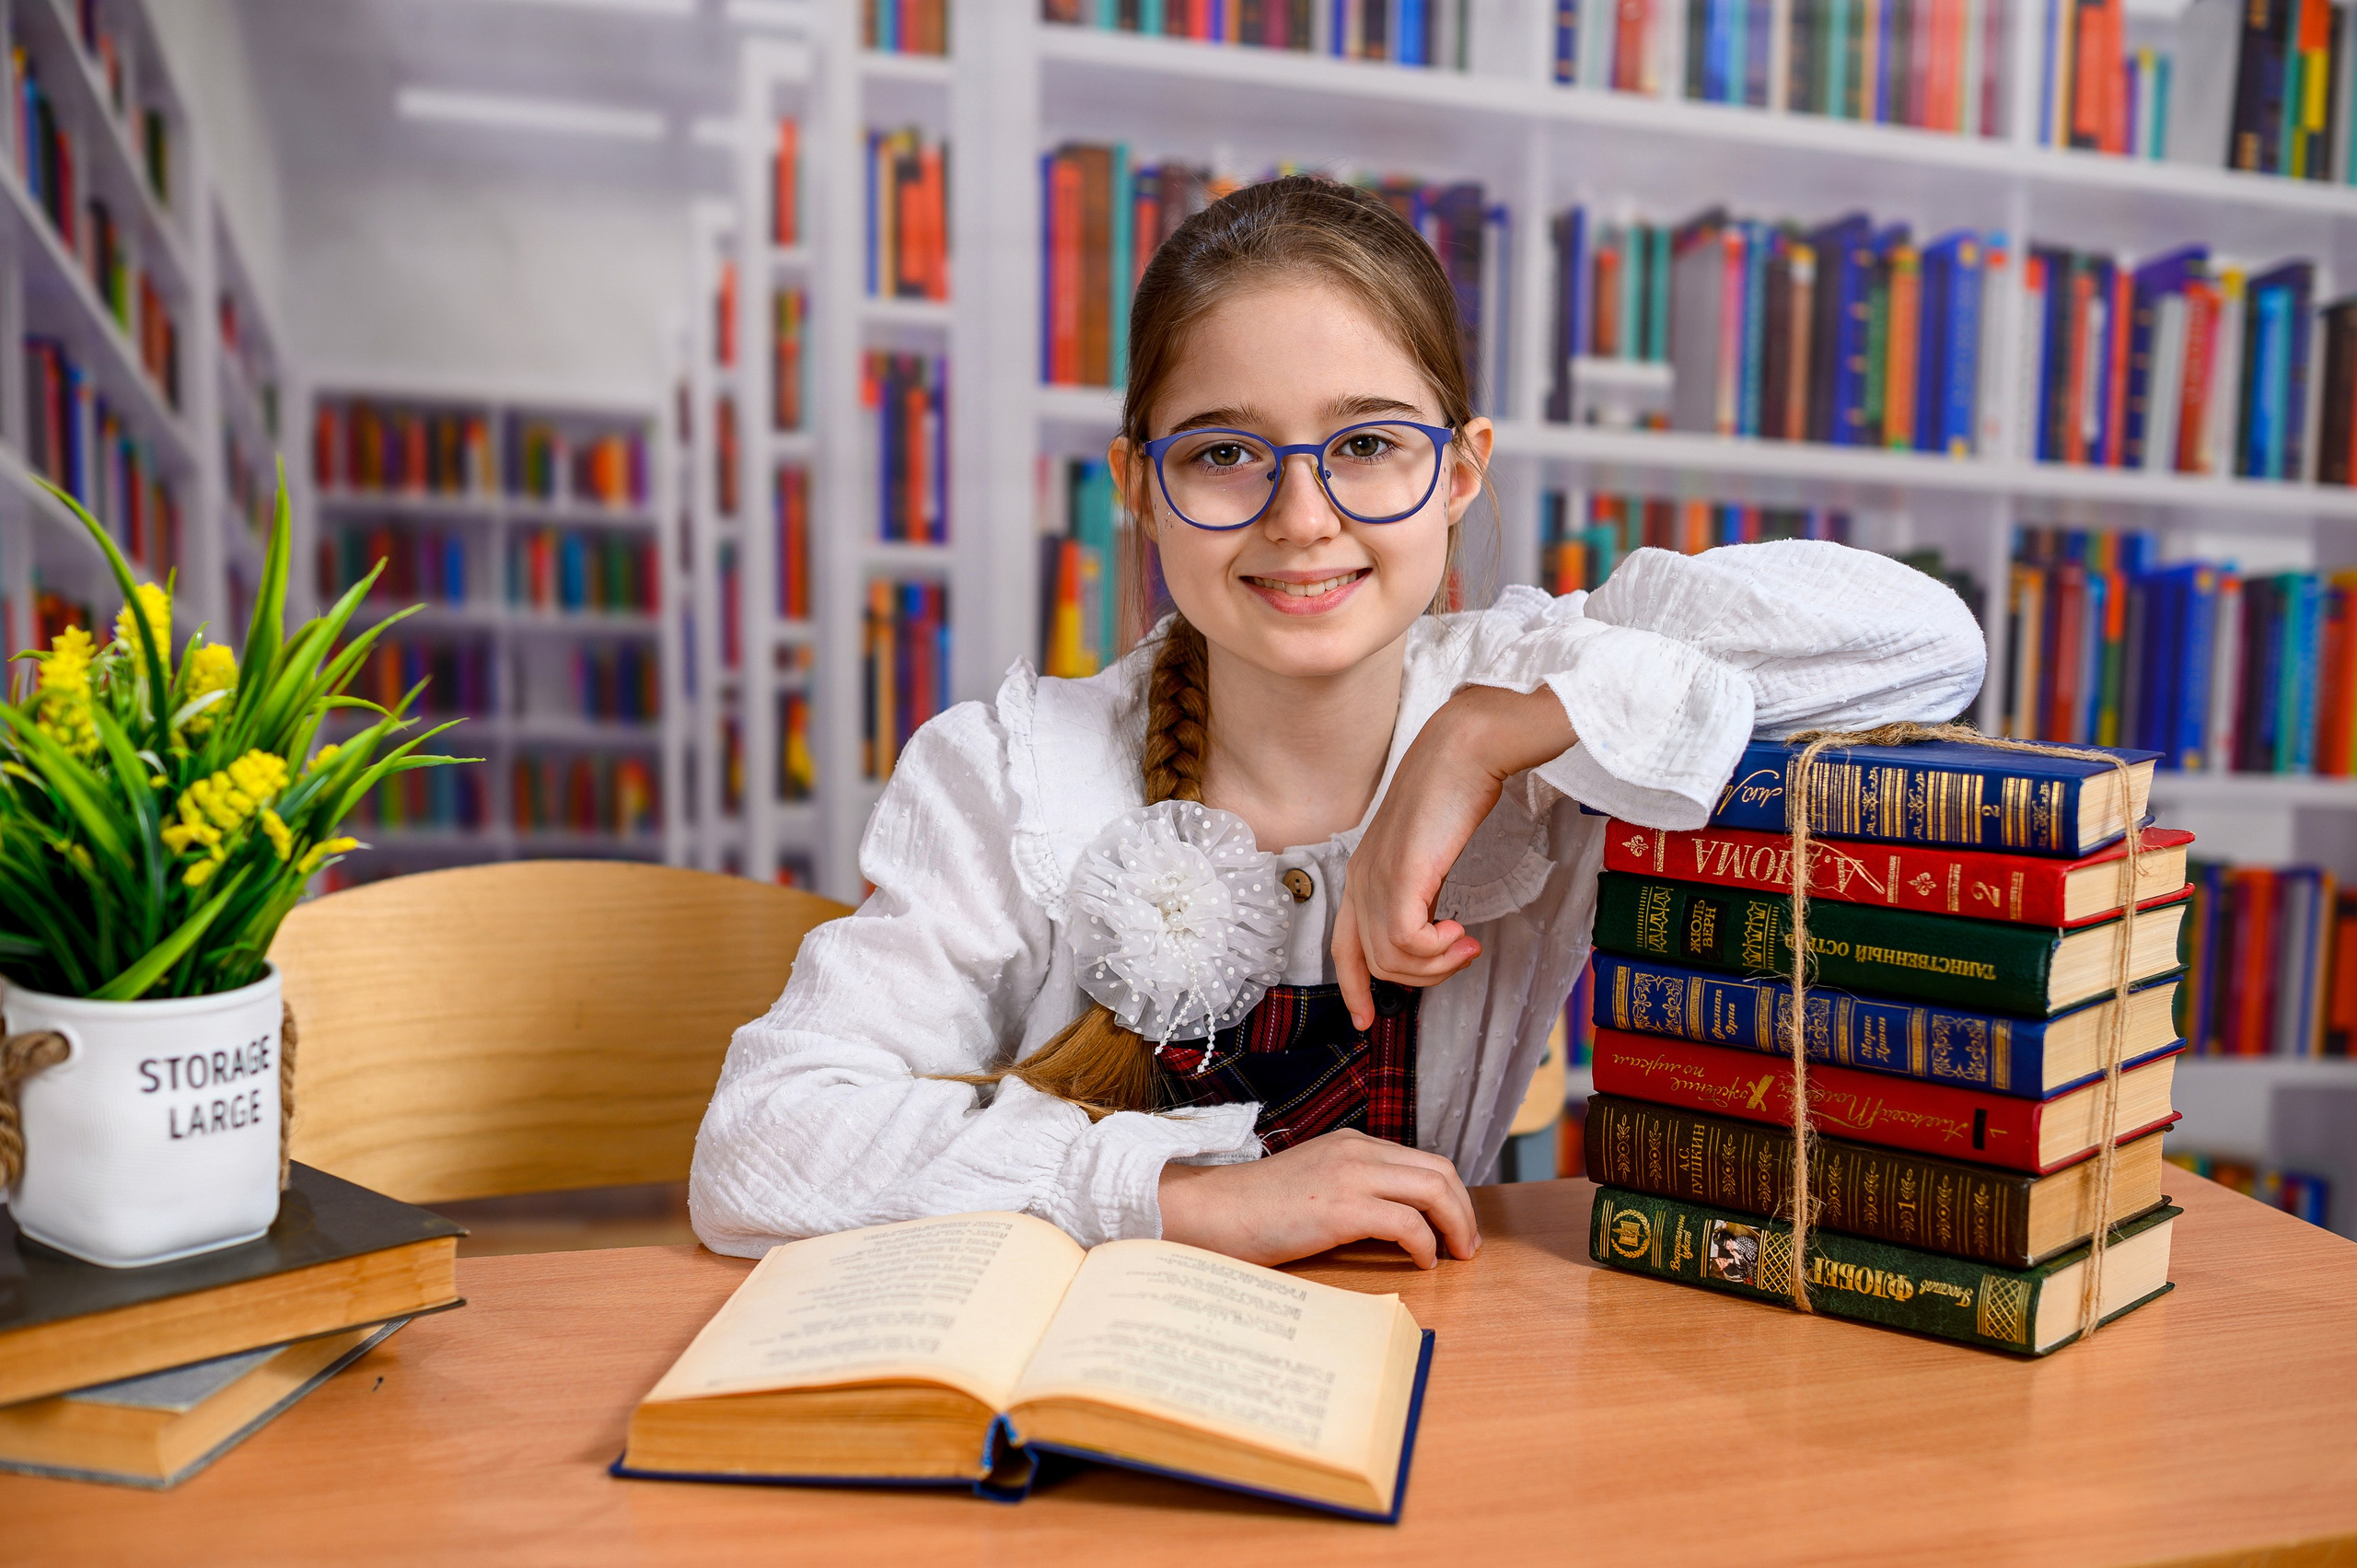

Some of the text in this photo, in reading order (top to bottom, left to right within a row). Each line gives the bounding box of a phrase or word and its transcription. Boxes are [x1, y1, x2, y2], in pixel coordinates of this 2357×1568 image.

[1981, 804, 2001, 818] 2
[1971, 881, 2001, 908] 2
[1690, 900, 1705, 954] ЖЮЛЬ
[1702, 906, 1717, 948] ВЕРН
[1784, 934, 1997, 980] ТАИНСТВЕННЫЙ ОСТРВ
[1712, 989, 1726, 1040] Филипп
[1861, 1015, 1876, 1059] Морис
[1875, 1016, 1891, 1063] Дрюон
[138, 1035, 270, 1094] STORAGE
[1612, 1053, 1705, 1077] по мукам
[169, 1089, 259, 1139] LARGE
[1669, 1074, 1775, 1112] Хождение
[1880, 1108, 1968, 1143] Алексей
[1898, 1201, 1916, 1212] 1
[1919, 1279, 1974, 1307] Густав
